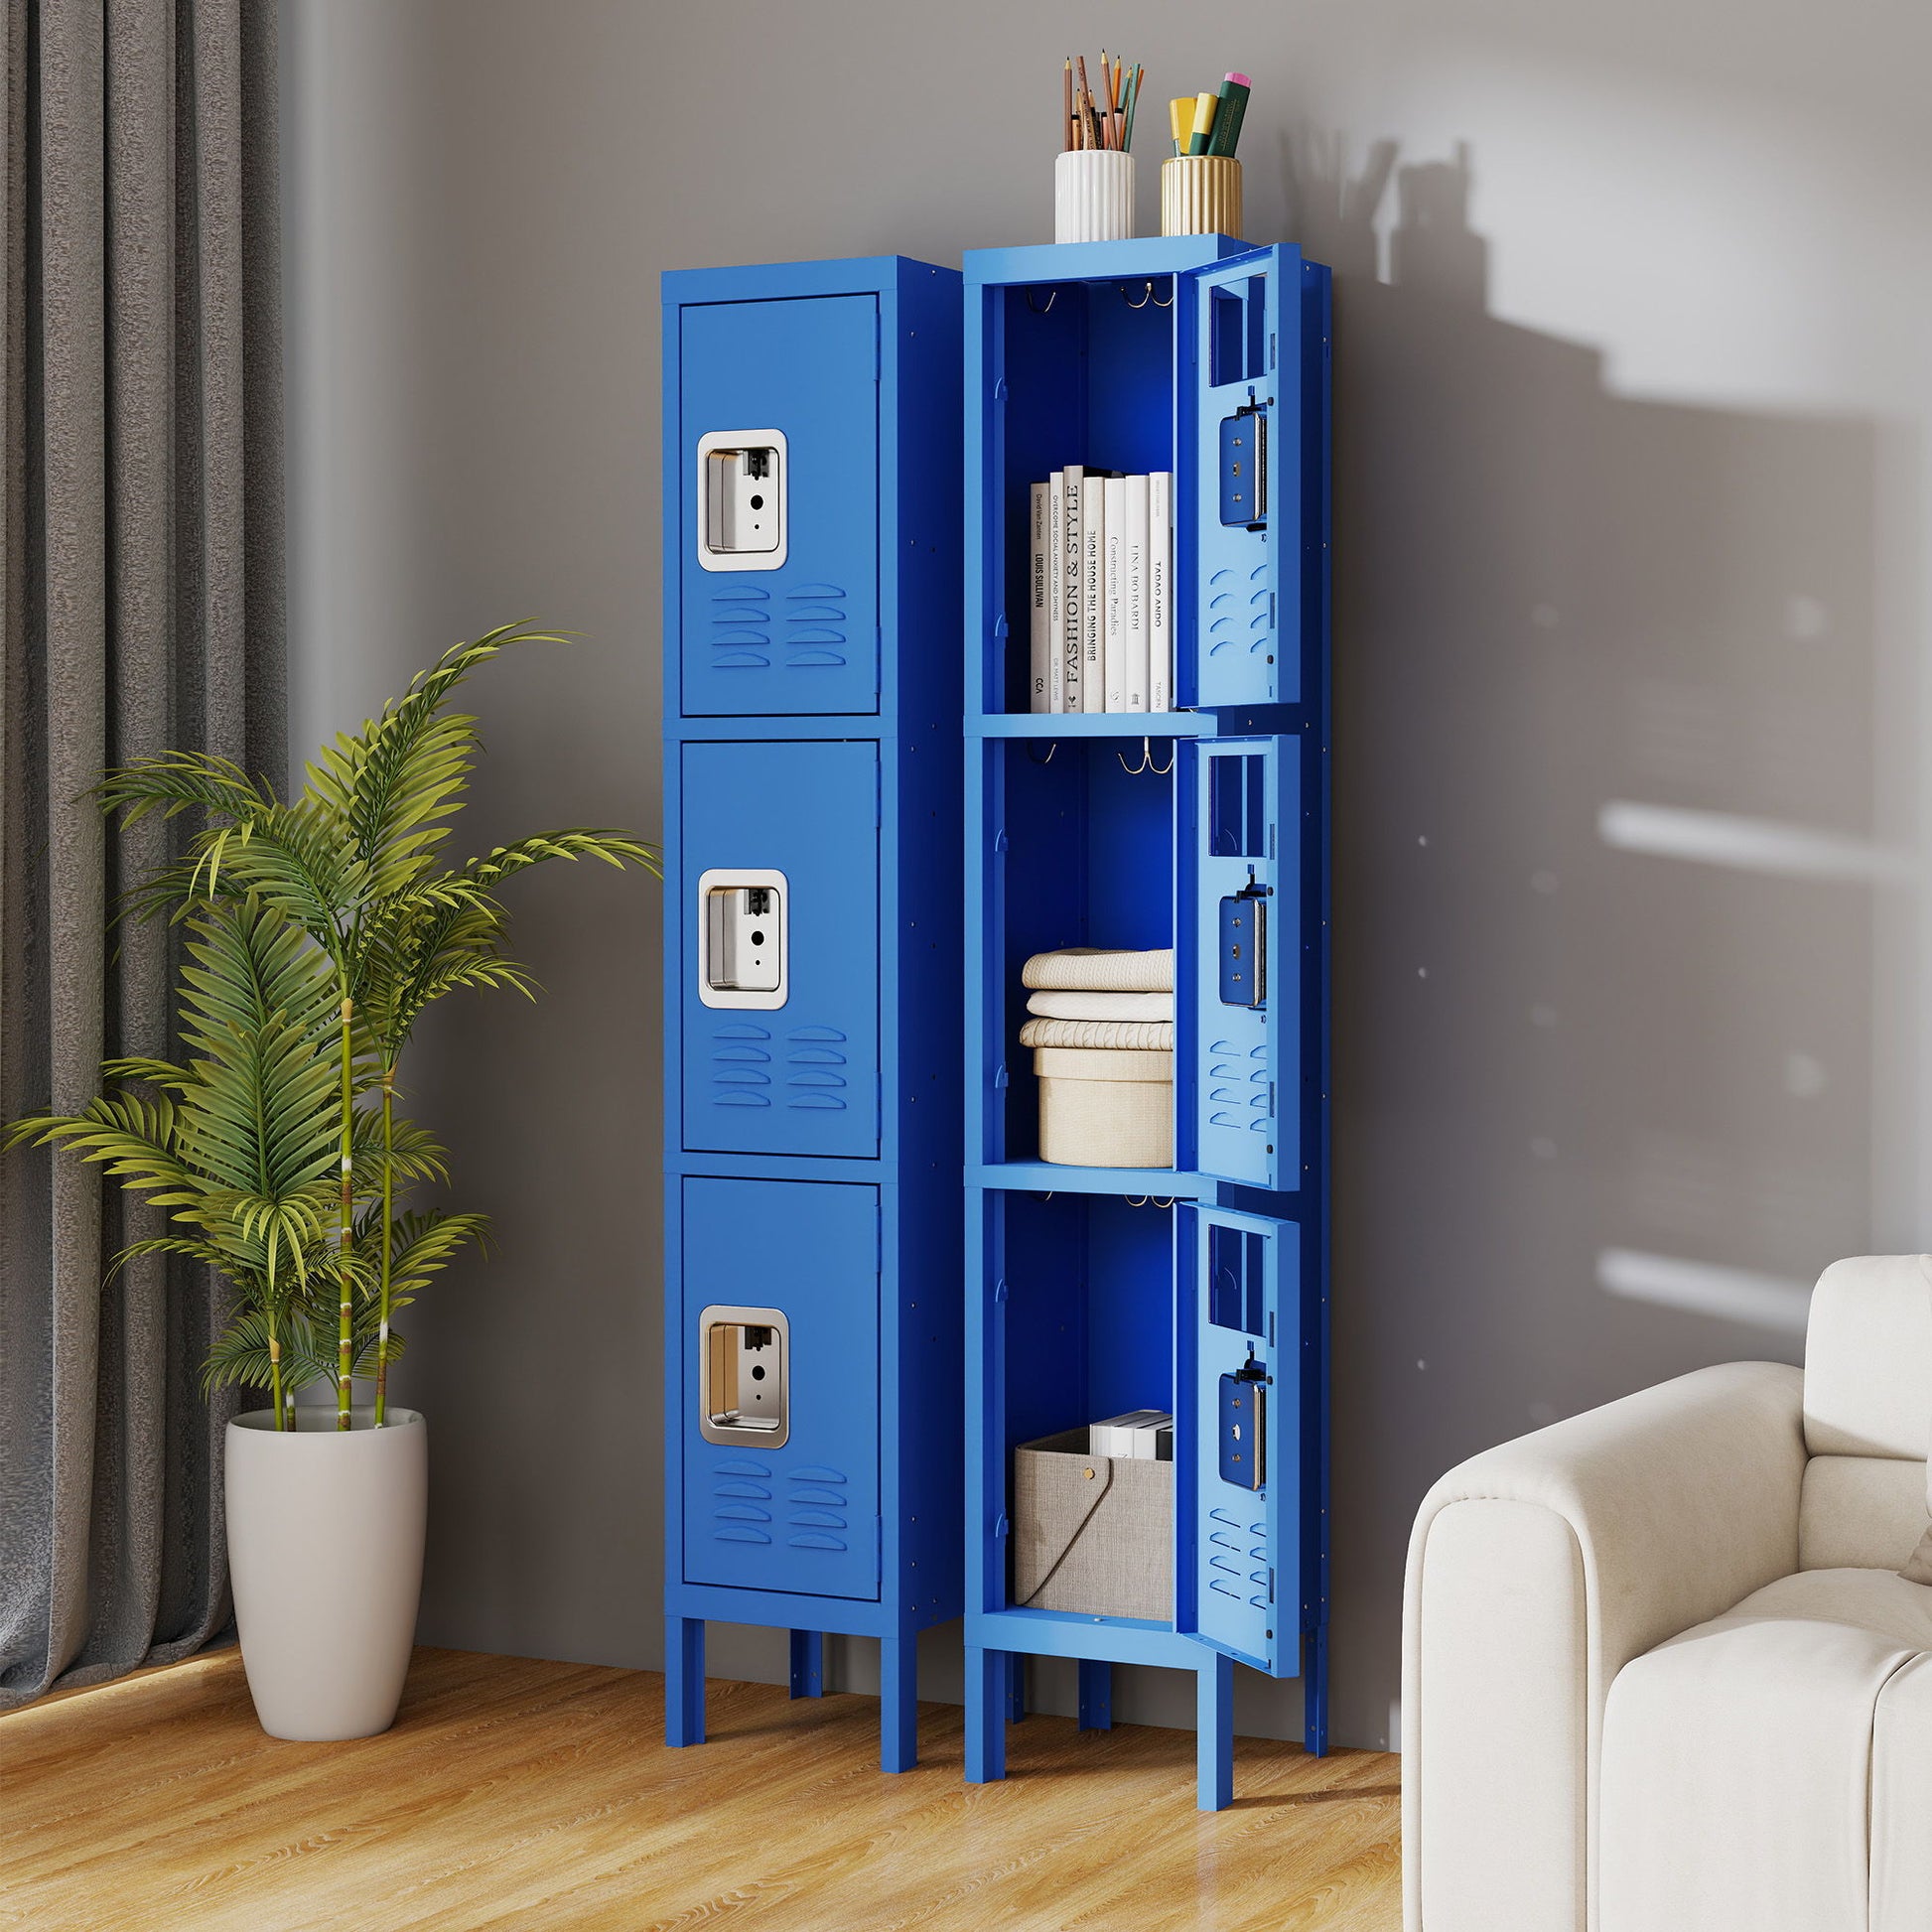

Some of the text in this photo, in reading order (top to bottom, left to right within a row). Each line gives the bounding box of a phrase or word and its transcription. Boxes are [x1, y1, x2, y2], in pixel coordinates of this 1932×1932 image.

[1035, 553, 1043, 608] LOUIS SULLIVAN
[1066, 484, 1078, 684] FASHION & STYLE
[1087, 530, 1096, 661] BRINGING THE HOUSE HOME
[1109, 536, 1119, 596] Constructing
[1131, 576, 1139, 592] BO
